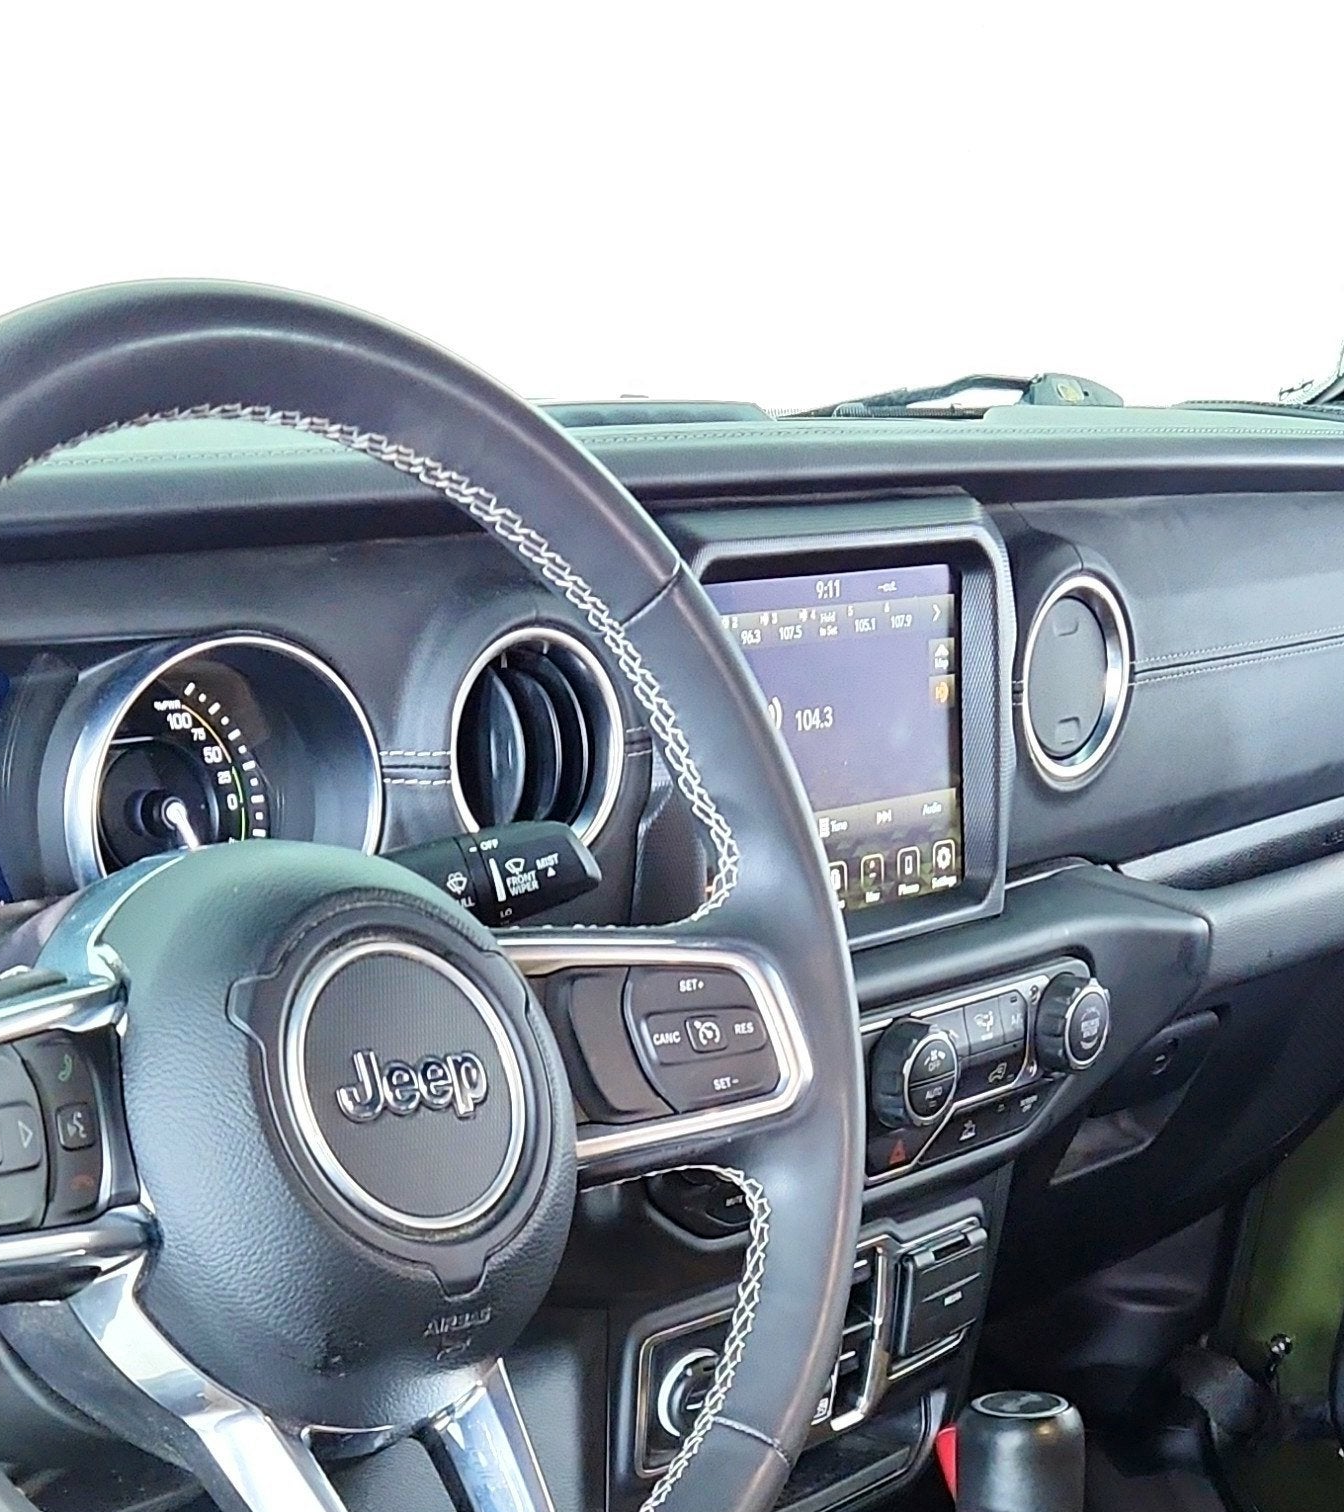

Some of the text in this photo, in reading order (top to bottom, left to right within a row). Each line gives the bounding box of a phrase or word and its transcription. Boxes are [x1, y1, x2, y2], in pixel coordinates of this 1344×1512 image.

[816, 579, 840, 599] 9:11
[855, 617, 876, 633] 105.1
[890, 615, 912, 629] 107.9
[741, 629, 761, 645] 96.3
[778, 625, 802, 640] 107.5
[167, 712, 192, 730] 100
[795, 706, 834, 731] 104.3
[191, 727, 206, 741] 75
[202, 746, 222, 764] 50
[226, 793, 238, 811] 0
[480, 838, 499, 851] OFF
[536, 853, 559, 870] MIST
[506, 869, 537, 886] FRONT
[508, 880, 540, 897] WIPER
[734, 1022, 754, 1034] RES
[653, 1031, 681, 1045] CANC
[928, 1059, 942, 1072] OFF
[336, 1050, 489, 1122] Jeep
[925, 1086, 943, 1100] AUTO
